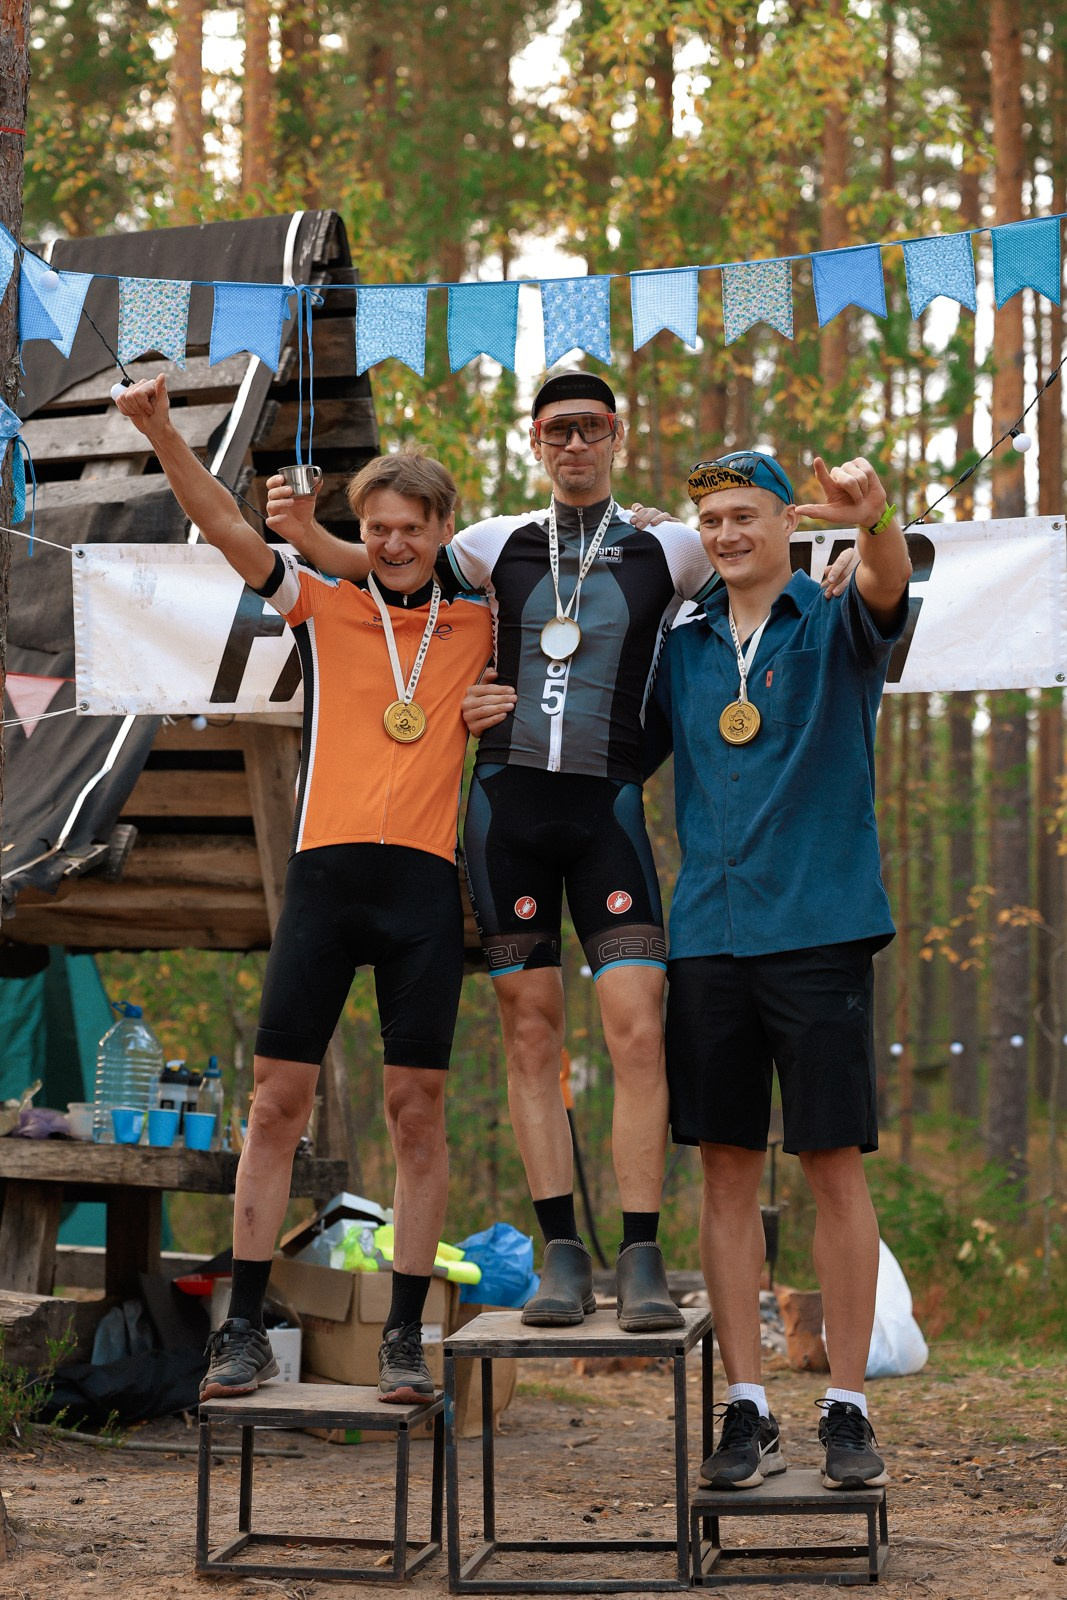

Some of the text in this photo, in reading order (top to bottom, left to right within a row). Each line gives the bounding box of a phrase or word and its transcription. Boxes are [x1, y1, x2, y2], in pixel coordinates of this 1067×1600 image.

[688, 473, 717, 488] SANTIC
[399, 718, 411, 730] 2
[732, 718, 745, 731] 3
